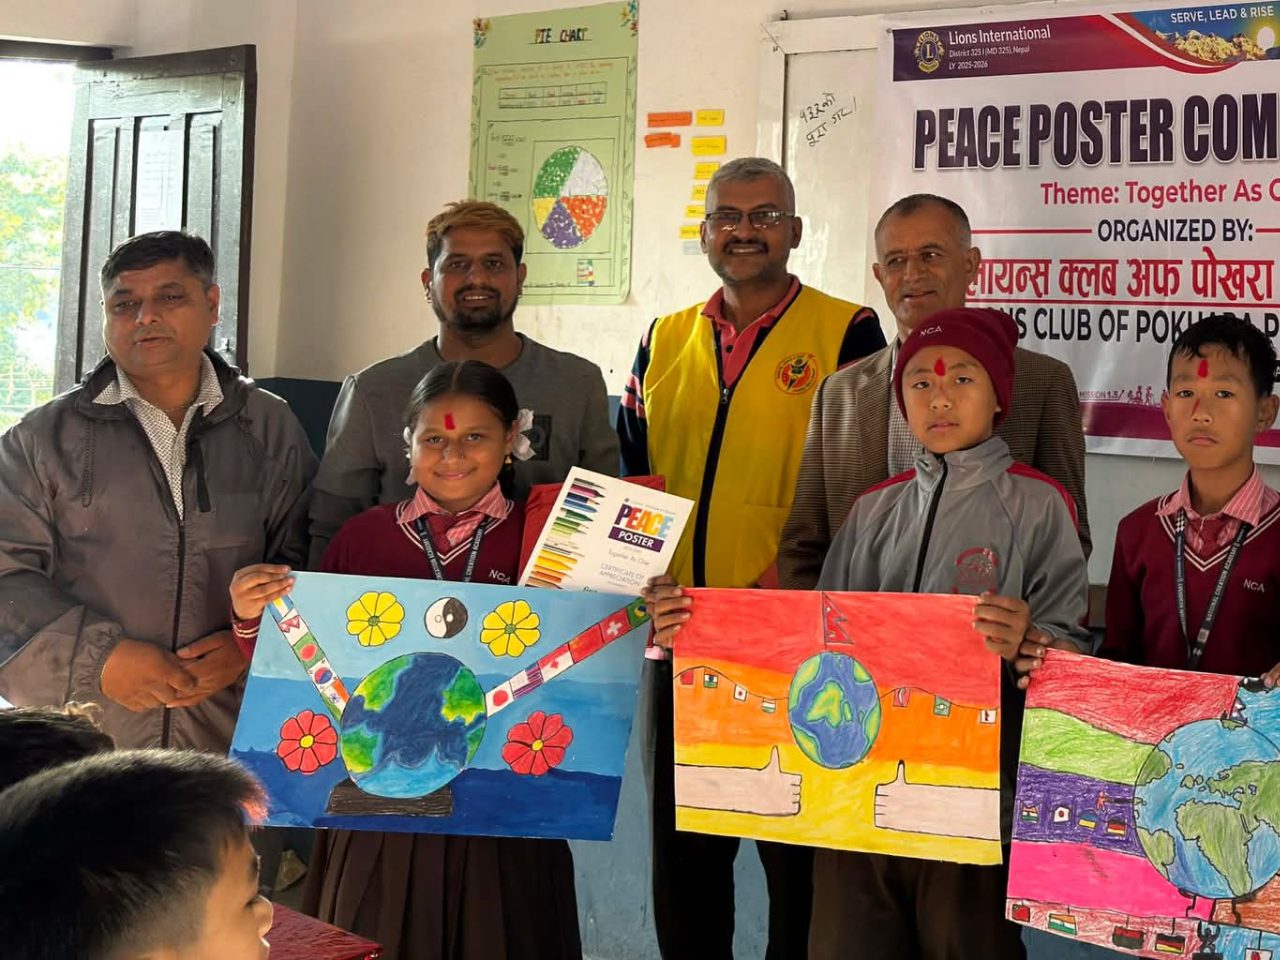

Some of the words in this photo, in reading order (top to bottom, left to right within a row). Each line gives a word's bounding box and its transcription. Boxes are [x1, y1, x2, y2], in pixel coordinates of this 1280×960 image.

[1170, 10, 1207, 24] SERVE,
[1209, 7, 1237, 21] LEAD
[1240, 7, 1247, 19] &
[1250, 5, 1275, 18] RISE
[949, 31, 977, 45] Lions
[980, 24, 1050, 43] International
[949, 49, 970, 57] District
[970, 48, 982, 56] 325
[1013, 45, 1030, 55] Nepal
[958, 60, 988, 70] 2025-2026
[914, 103, 1022, 171] PEACE
[1029, 93, 1174, 167] POSTER
[1041, 182, 1119, 205] Theme:
[1125, 180, 1227, 209] Together
[1233, 180, 1263, 202] As
[1098, 219, 1215, 244] ORGANIZED
[1222, 218, 1253, 242] BY:
[1059, 258, 1119, 298] क्लब
[1127, 258, 1183, 298] अफ
[1191, 246, 1274, 301] पोखरा
[920, 325, 943, 337] NCA
[1034, 307, 1092, 341] CLUB
[1098, 308, 1130, 342] OF
[614, 503, 674, 539] PEACE
[618, 530, 654, 548] POSTER
[1243, 578, 1265, 593] NCA
